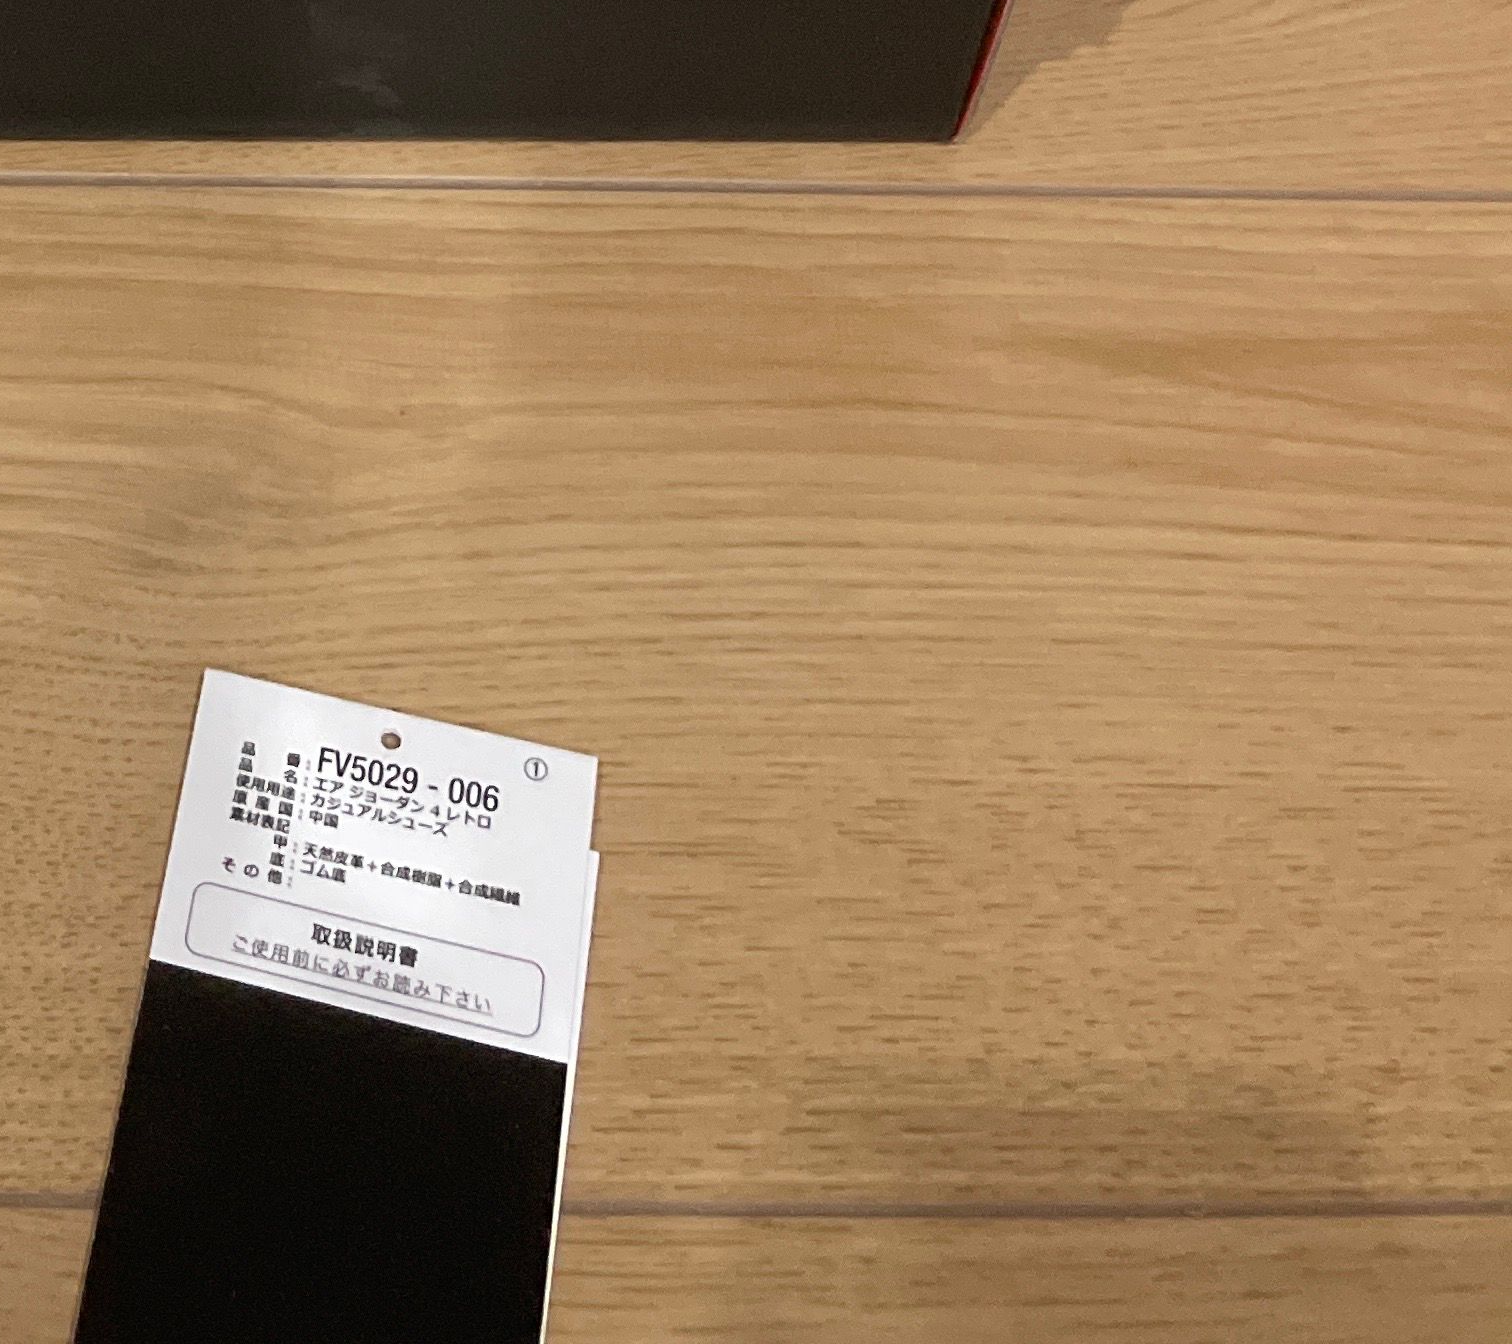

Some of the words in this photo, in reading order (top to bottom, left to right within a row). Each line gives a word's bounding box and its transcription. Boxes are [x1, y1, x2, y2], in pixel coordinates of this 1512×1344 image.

[317, 746, 419, 795] FV5029
[448, 777, 500, 813] 006
[231, 934, 494, 1012] ご使用前に必ずお読み下さい
[311, 922, 419, 968] 取扱説明書
